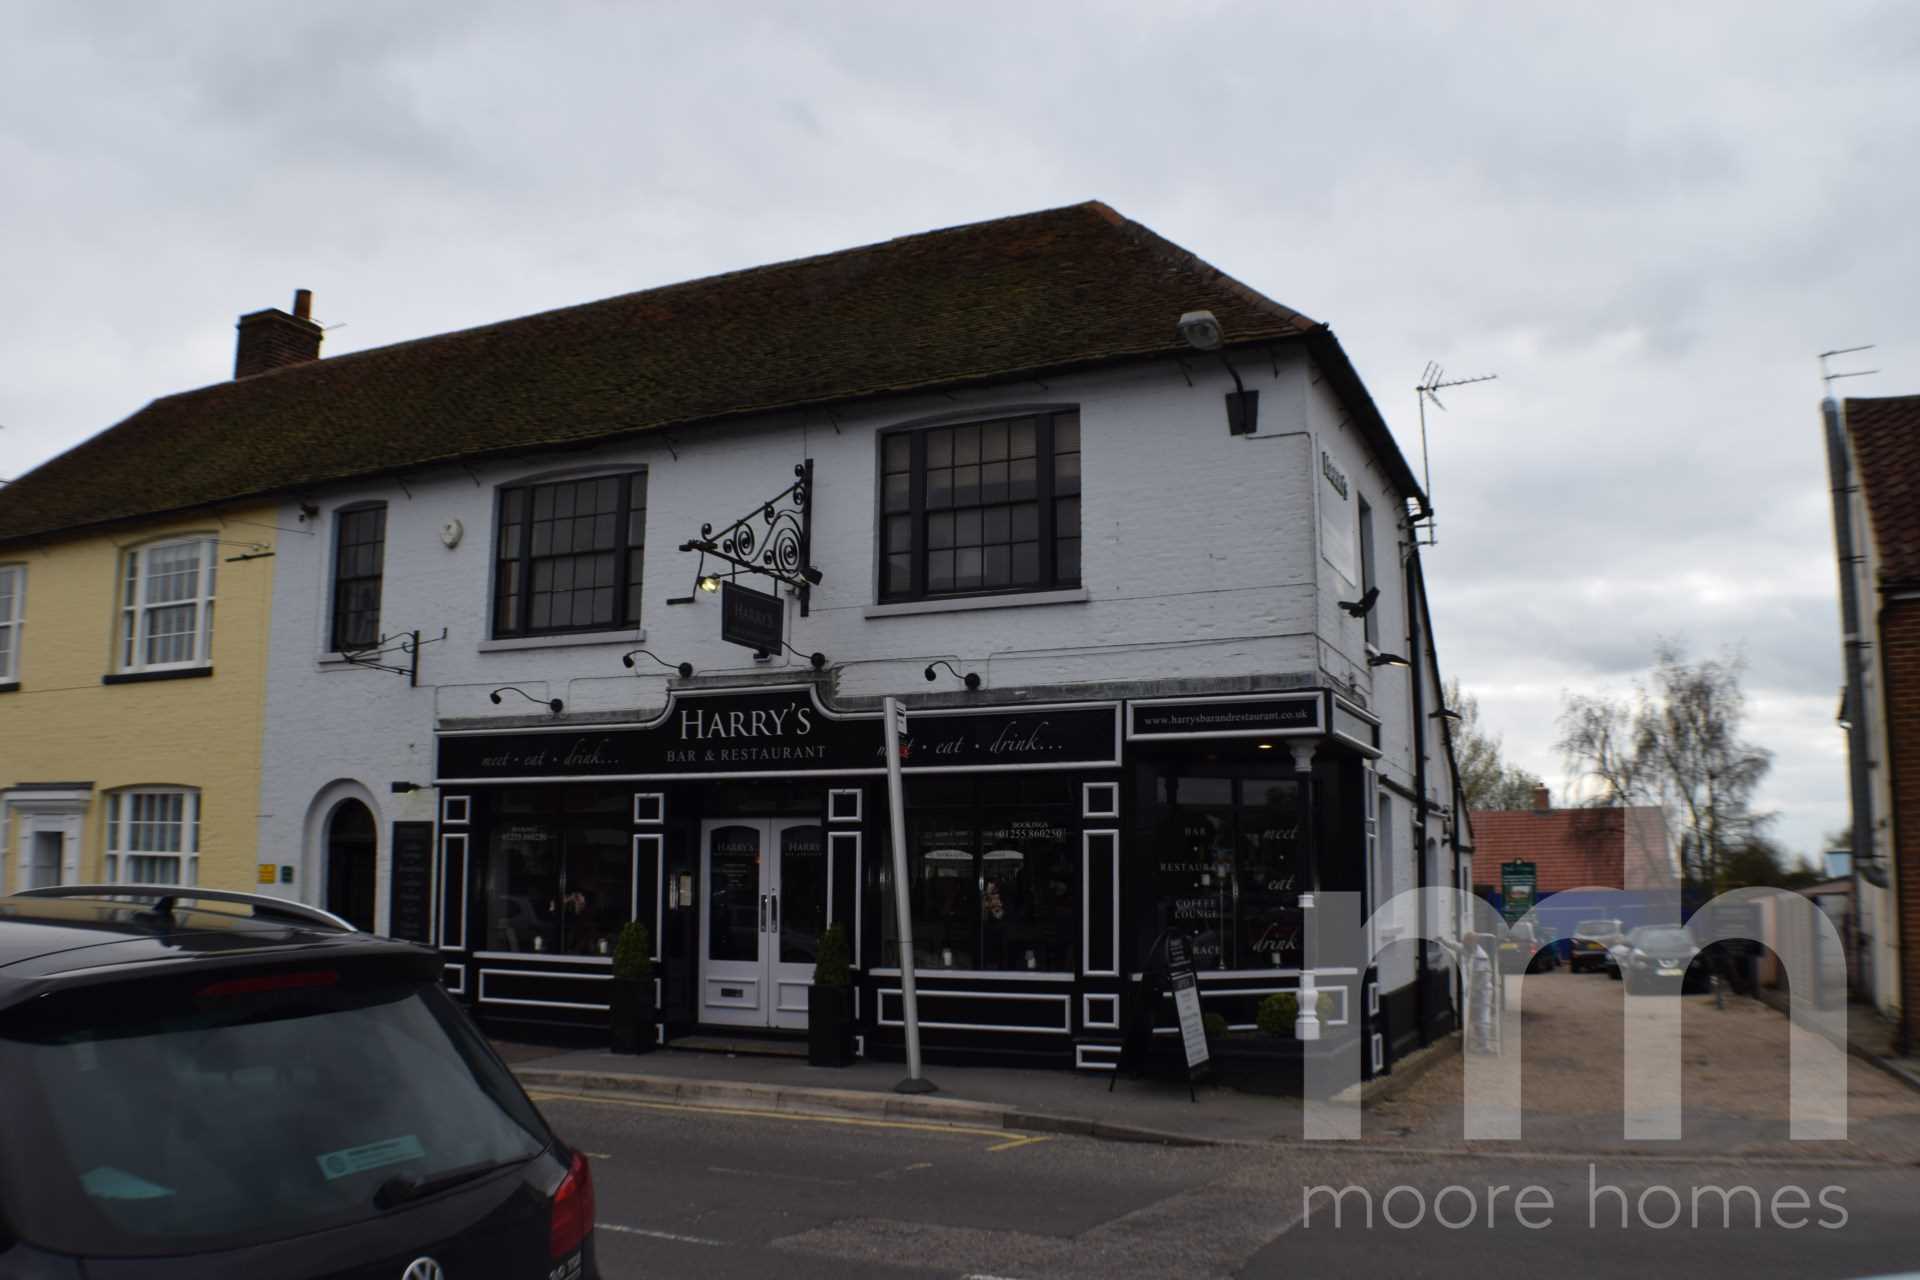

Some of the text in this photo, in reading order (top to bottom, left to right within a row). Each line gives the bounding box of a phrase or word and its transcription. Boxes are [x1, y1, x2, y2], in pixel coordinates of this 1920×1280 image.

[680, 702, 811, 740] HARRY'S
[1144, 709, 1308, 726] www.harrysbarandrestaurant.co.uk
[936, 736, 965, 754] eat
[666, 746, 826, 762] BAR & RESTAURANT
[1264, 824, 1297, 840] meet
[1268, 874, 1296, 890] eat
[1176, 899, 1216, 910] COFFEE
[1175, 910, 1217, 919] LOUNGE
[1252, 921, 1296, 952] drink
